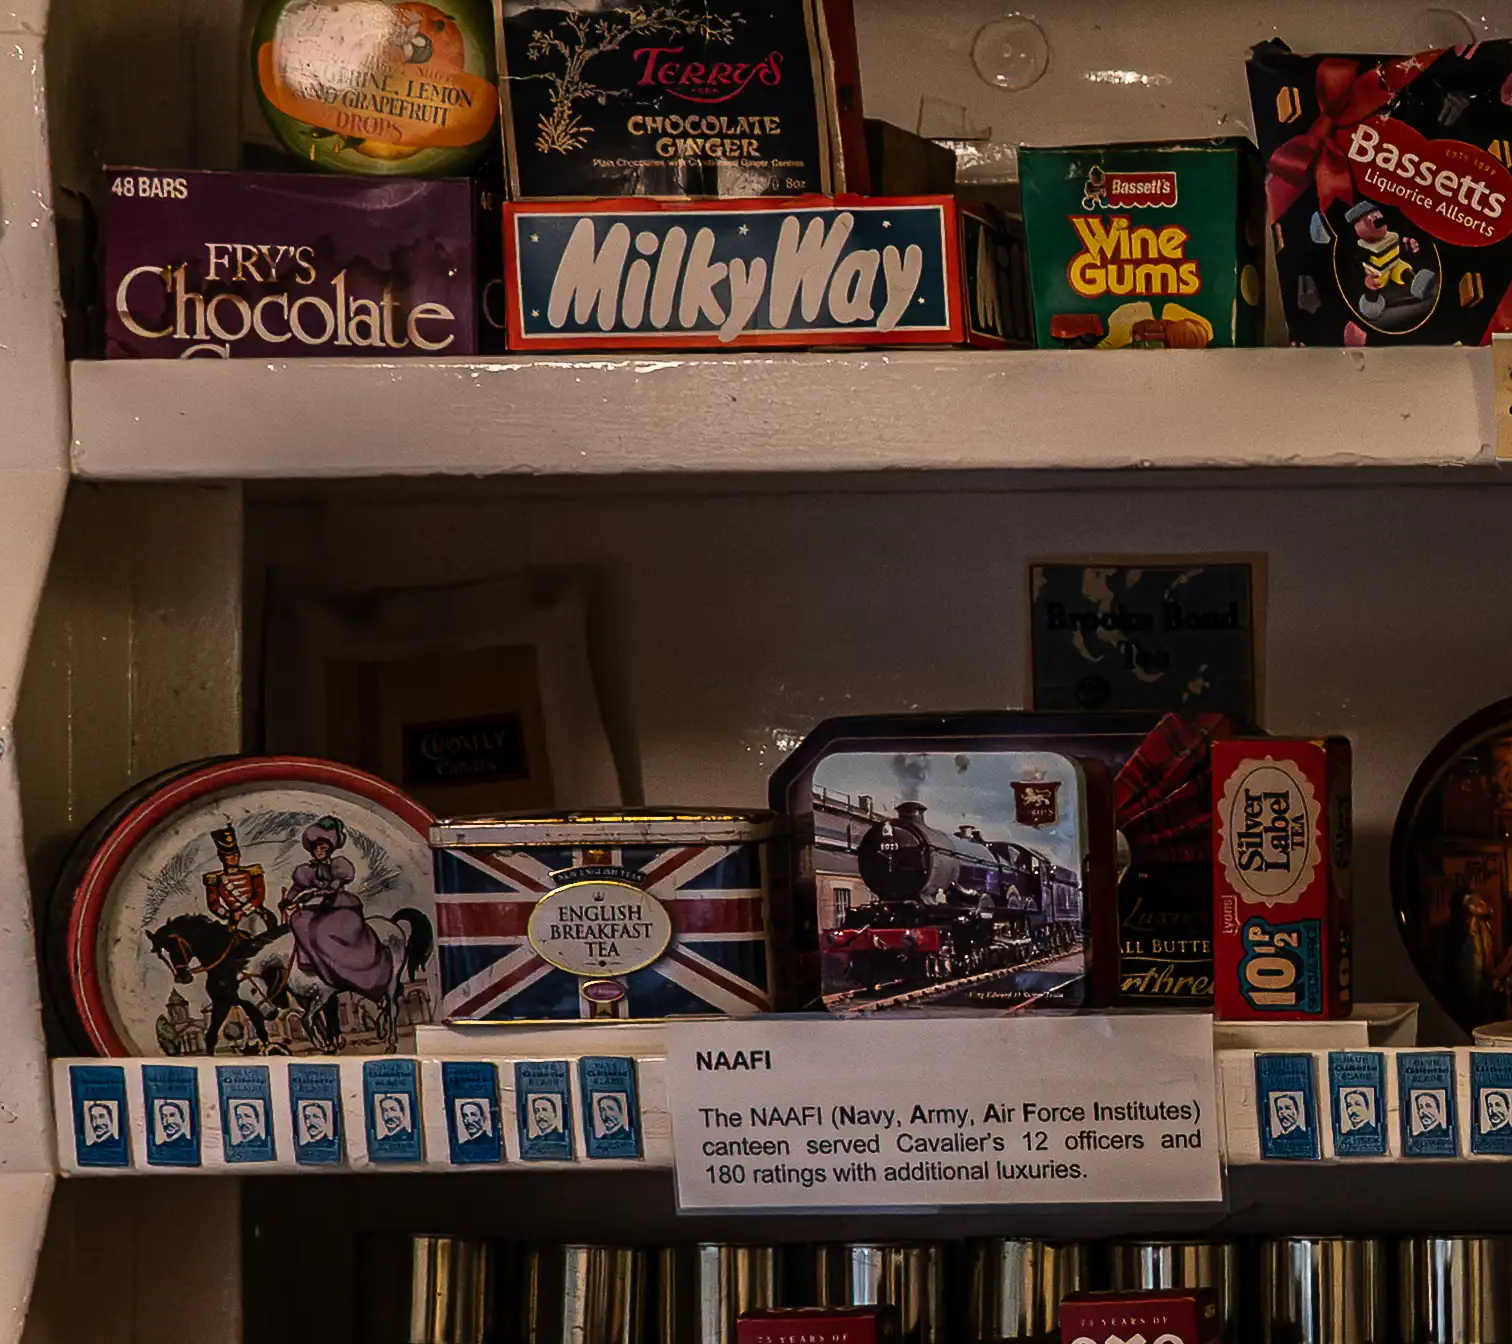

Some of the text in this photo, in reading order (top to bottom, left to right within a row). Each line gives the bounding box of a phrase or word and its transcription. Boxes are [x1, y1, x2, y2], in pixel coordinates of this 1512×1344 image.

[627, 114, 782, 138] CHOCOLATE
[655, 137, 761, 159] GINGER
[111, 177, 188, 200] 48 BARS
[1348, 122, 1508, 221] Bassetts
[1362, 167, 1496, 238] Liquorice Allsorts
[1071, 215, 1189, 263] Wine
[204, 243, 316, 286] FRY'S
[550, 212, 924, 343] Milky Way
[1069, 254, 1202, 299] Gums
[115, 264, 456, 349] Chocolate
[1237, 787, 1266, 875] Silver
[1262, 789, 1292, 875] Label
[1290, 814, 1306, 851] TEA
[549, 922, 653, 941] BREAKFAST
[557, 905, 643, 925] ENGLISH
[586, 942, 620, 959] TEA
[696, 1050, 771, 1071] NAAFI
[699, 1099, 1201, 1130] The NAAFI (Navy, Army, Air Force Institutes)
[702, 1129, 1202, 1156] canteen served Cavalier's 12 officers and
[705, 1160, 1088, 1188] 180 ratings with additional luxuries.
